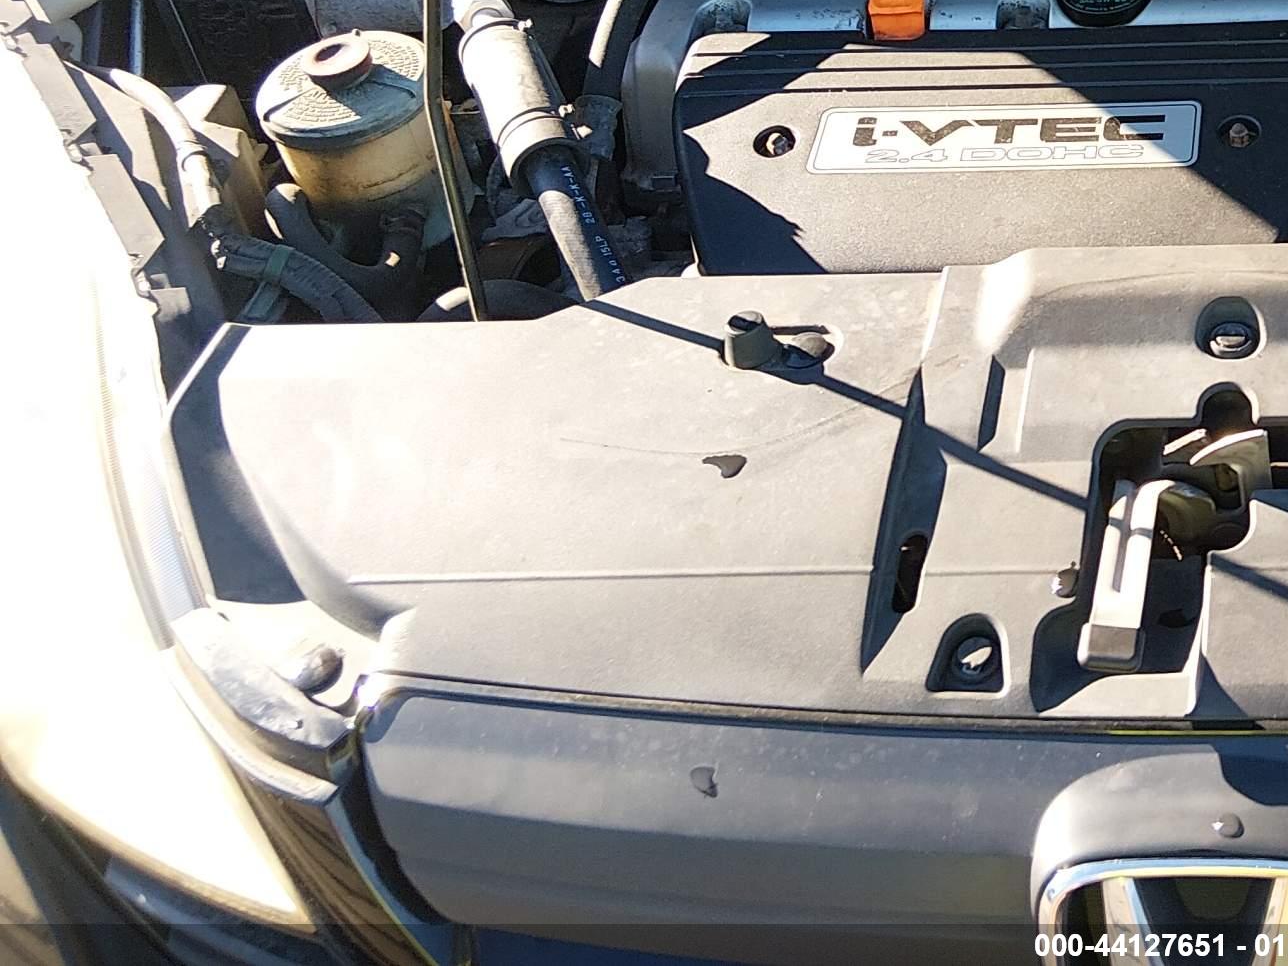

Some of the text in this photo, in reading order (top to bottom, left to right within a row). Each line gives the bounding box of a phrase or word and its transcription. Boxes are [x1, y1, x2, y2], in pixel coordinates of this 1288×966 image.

[852, 114, 1166, 147] i-VTEC
[865, 144, 1144, 164] 2.4 DOHC
